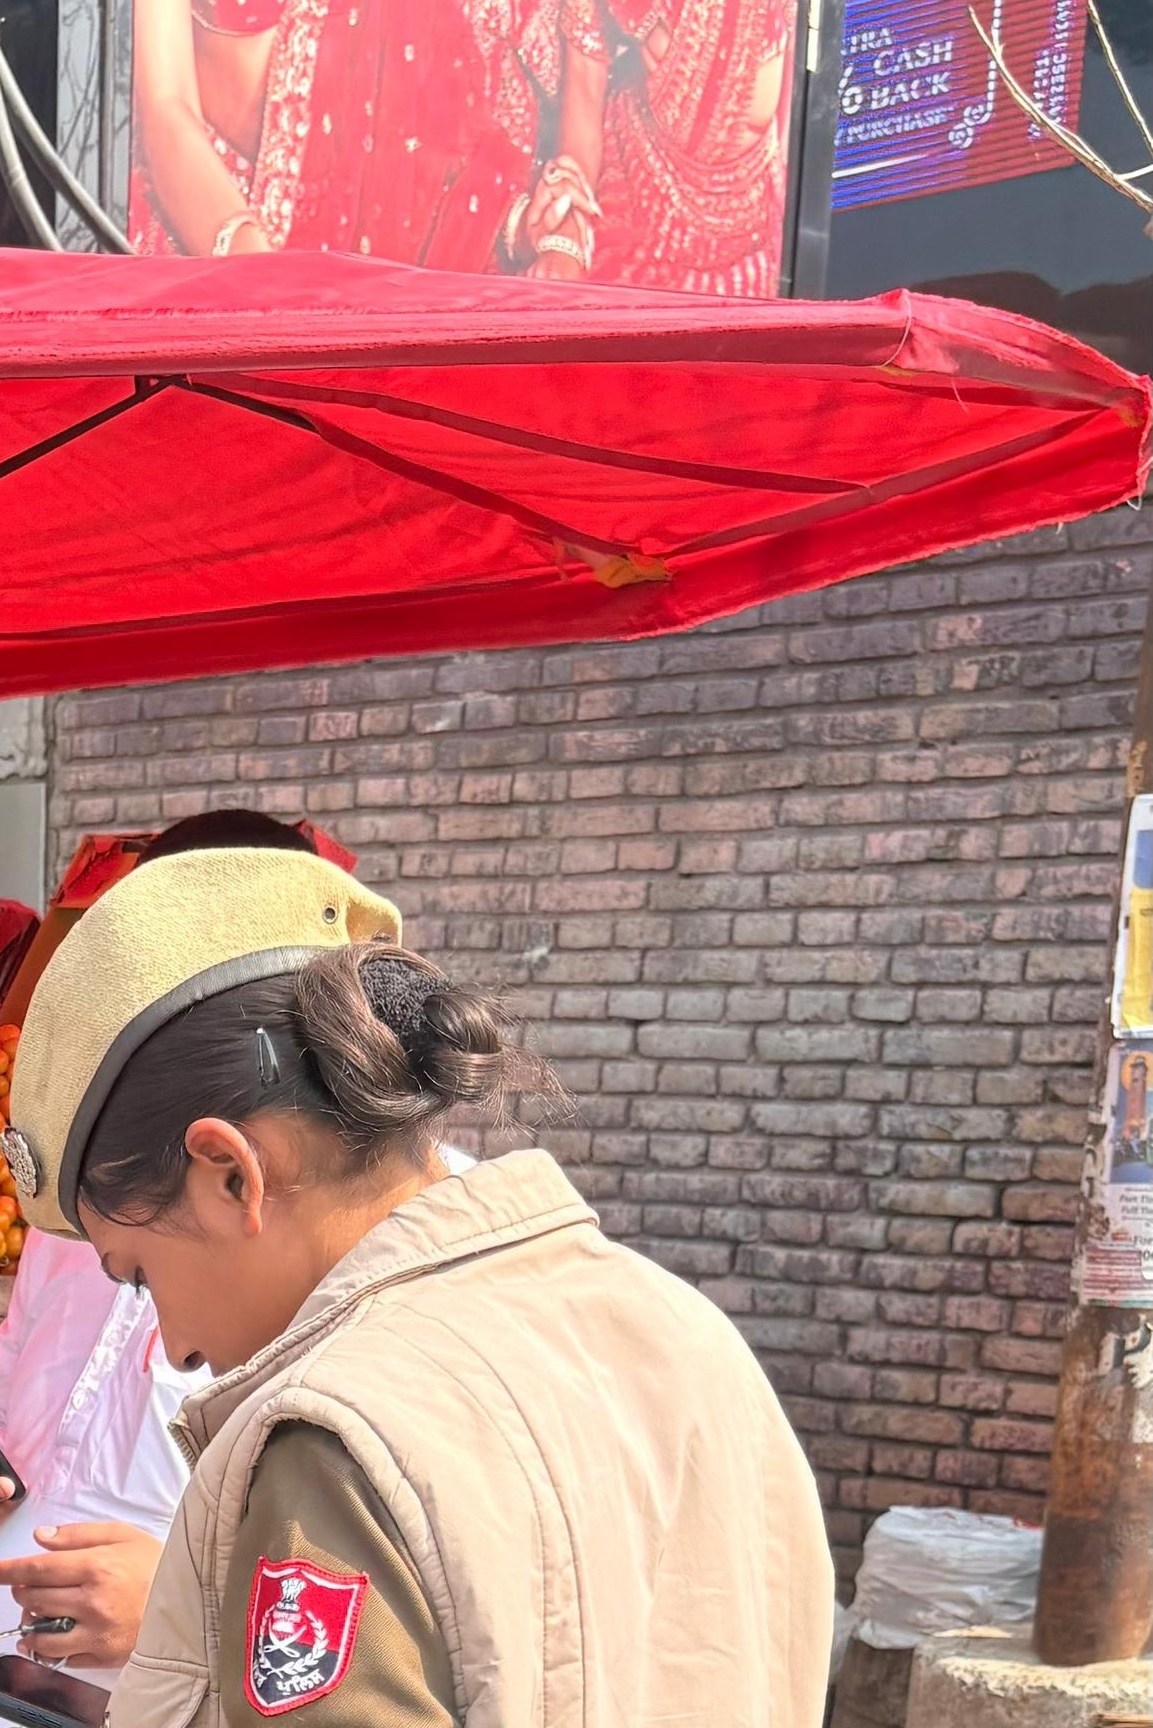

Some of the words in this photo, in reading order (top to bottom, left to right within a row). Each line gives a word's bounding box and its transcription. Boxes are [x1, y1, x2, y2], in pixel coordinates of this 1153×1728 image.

[841, 28, 893, 55] TRA
[873, 40, 953, 76] CASH
[870, 72, 950, 110] BACK
